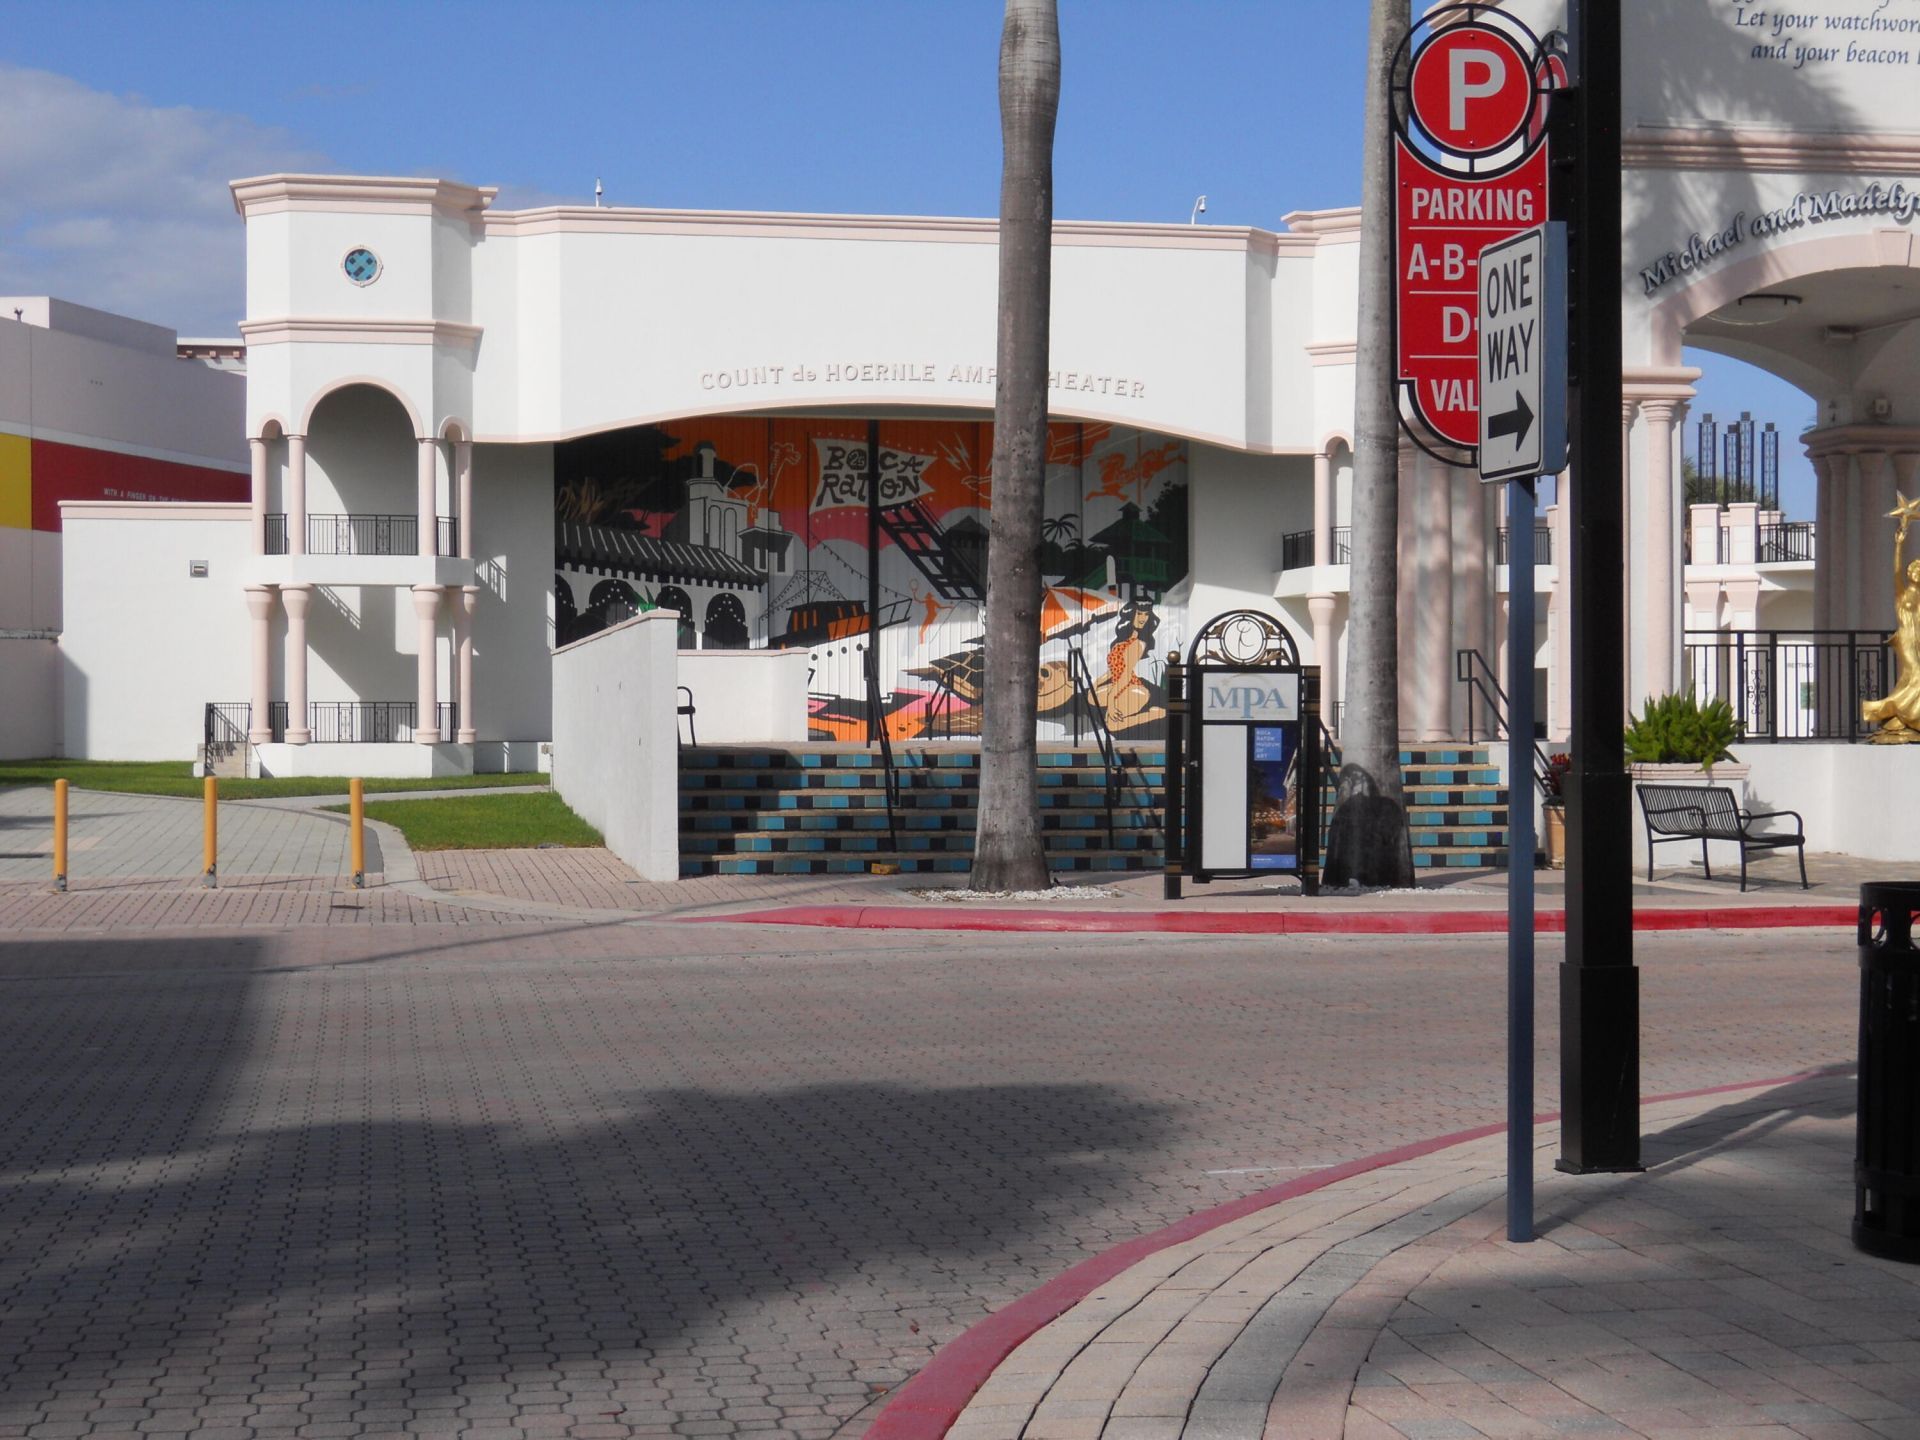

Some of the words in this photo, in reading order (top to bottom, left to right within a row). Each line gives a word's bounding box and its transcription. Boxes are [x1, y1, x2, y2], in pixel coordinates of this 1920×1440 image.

[1734, 7, 1767, 27] Let
[1771, 13, 1819, 37] your
[1824, 8, 1920, 33] watchwor
[1751, 37, 1793, 60] and
[1793, 45, 1840, 70] your
[1846, 40, 1909, 65] beacon
[1449, 48, 1506, 131] P
[1411, 187, 1533, 221] PARKING
[1640, 211, 1745, 298] Michael
[1750, 192, 1806, 238] and
[1808, 181, 1920, 224] Madely
[1406, 243, 1490, 281] A-B-
[1486, 253, 1533, 318] ONE
[1487, 318, 1535, 384] WAY
[701, 366, 784, 390] COUNT
[792, 364, 817, 382] de
[825, 363, 936, 382] HOERNLE
[1208, 686, 1288, 719] MPA
